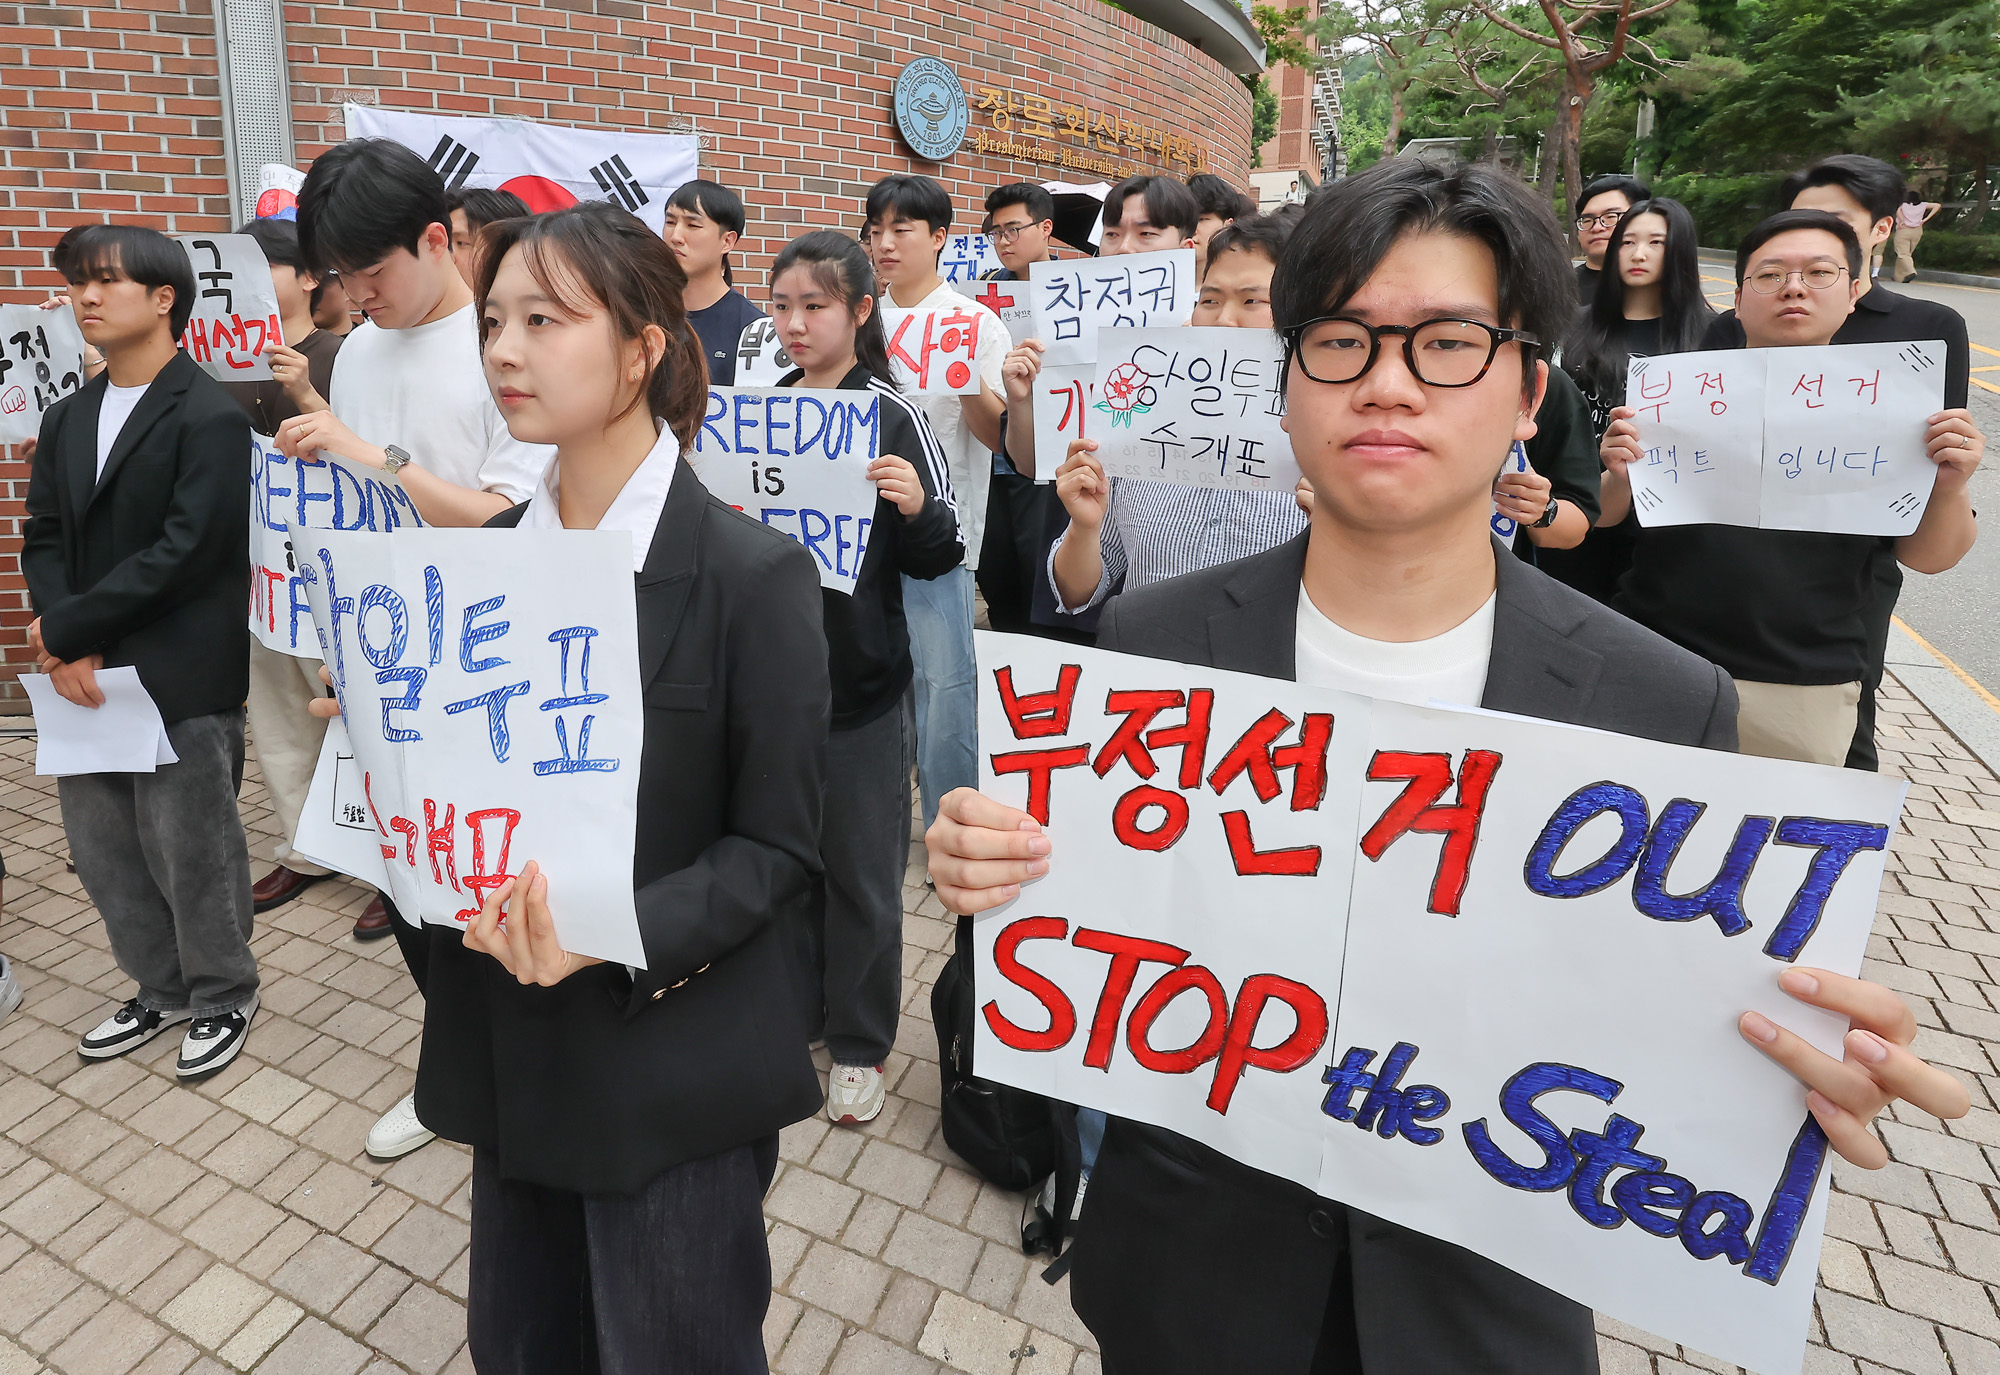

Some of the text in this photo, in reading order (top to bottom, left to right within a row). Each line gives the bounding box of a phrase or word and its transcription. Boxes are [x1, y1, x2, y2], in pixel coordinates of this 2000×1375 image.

[900, 115, 963, 156] PIETAS ET SCIENTIA
[923, 130, 942, 141] 1901
[976, 130, 1056, 162] Presbyterian
[1060, 147, 1114, 179] University
[1118, 164, 1133, 178] and
[977, 87, 1212, 175] 장로회신학대학교
[192, 240, 232, 314] 국
[953, 236, 988, 259] 전국
[886, 311, 985, 389] 사형
[695, 391, 879, 460] REEDOM
[1140, 421, 1271, 479] 수개표
[250, 439, 423, 533] REEDOM
[751, 461, 785, 496] is
[991, 663, 1890, 963] 부정선거 OUT
[981, 915, 1830, 1287] STOP the Steal
